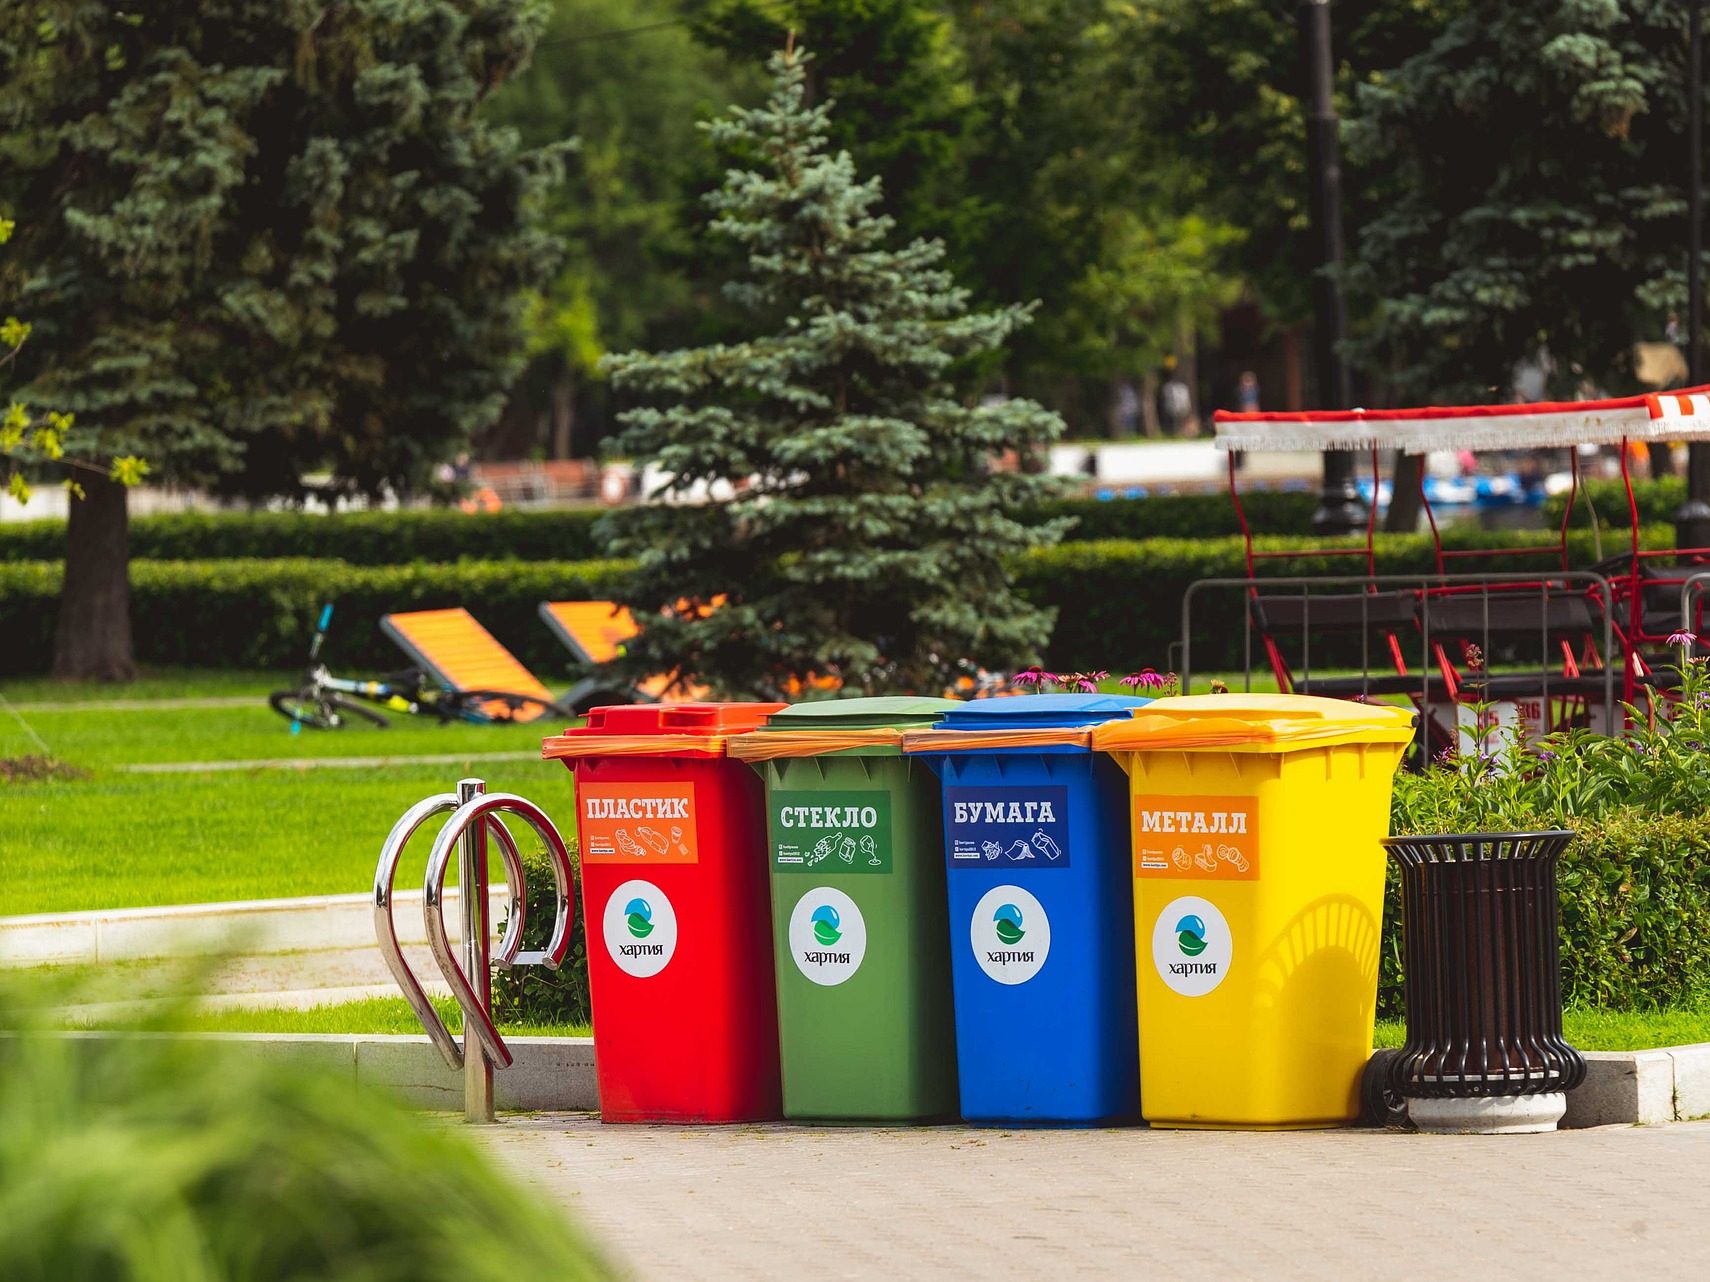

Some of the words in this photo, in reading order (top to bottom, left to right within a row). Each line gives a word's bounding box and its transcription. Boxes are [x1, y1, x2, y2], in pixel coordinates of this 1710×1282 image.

[587, 798, 688, 819] ПЛАСТИК
[780, 806, 878, 828] СТЕКЛО
[953, 801, 1056, 823] БУМАГА
[1141, 811, 1248, 834] МЕТАЛЛ
[618, 944, 664, 959] хартия
[803, 951, 851, 966] хартия
[986, 950, 1035, 966] хартия
[1168, 962, 1217, 978] хартия
